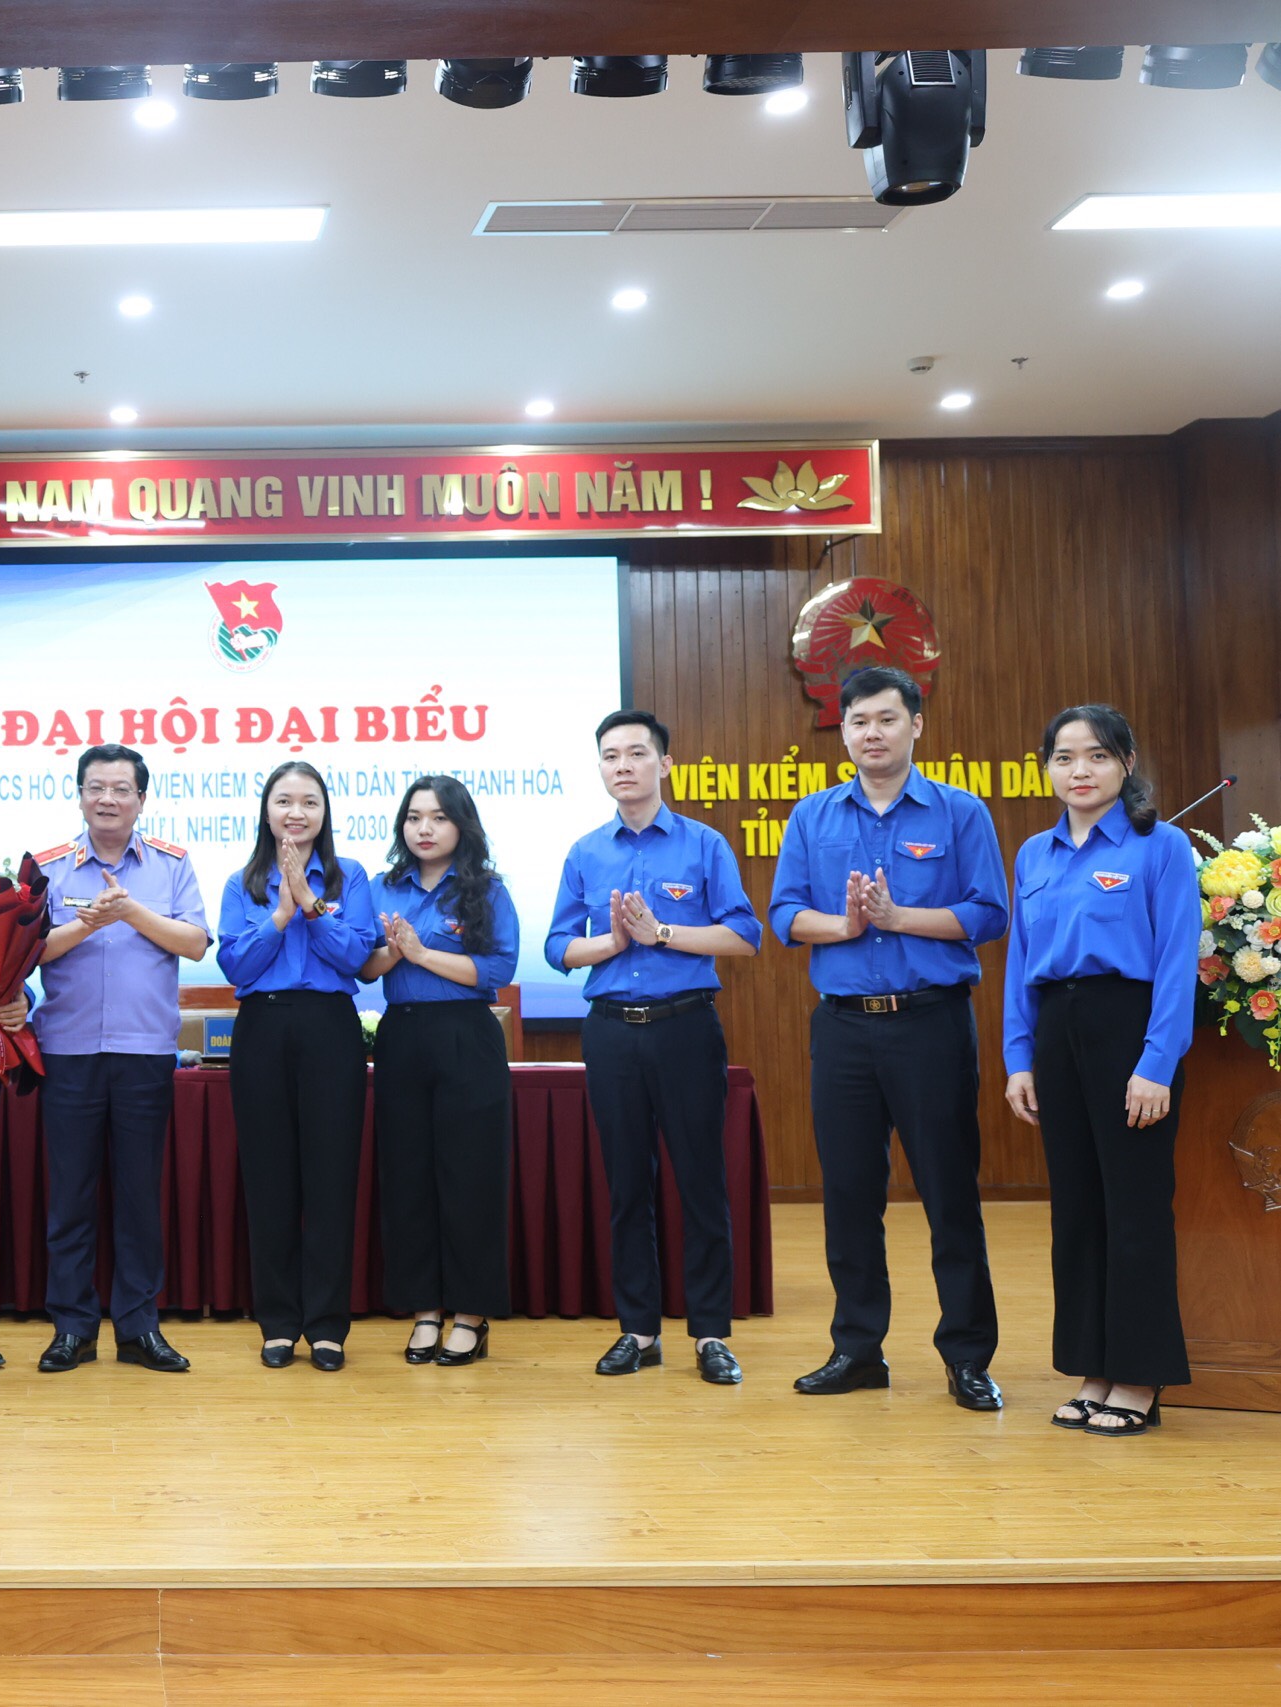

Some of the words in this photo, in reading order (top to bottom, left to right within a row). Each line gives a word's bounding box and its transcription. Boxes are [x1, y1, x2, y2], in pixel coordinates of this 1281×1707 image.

[4, 478, 114, 523] NAM
[128, 476, 283, 524] QUANG
[297, 474, 405, 517] VINH
[422, 461, 559, 516] MUÔN
[575, 460, 683, 513] NĂM
[1, 709, 105, 755] ĐẠI
[120, 696, 220, 754] HỘI
[235, 707, 340, 752] ĐẠI
[354, 684, 489, 742] BIỂU
[152, 771, 194, 805] VIỆN
[356, 764, 395, 796] DÂN
[522, 763, 563, 795] HÓA
[671, 756, 740, 809] VIỆN
[748, 745, 826, 800] KIỂM
[187, 814, 245, 848] NHIỆM
[347, 815, 387, 841] 2030
[741, 807, 789, 856] TỈN
